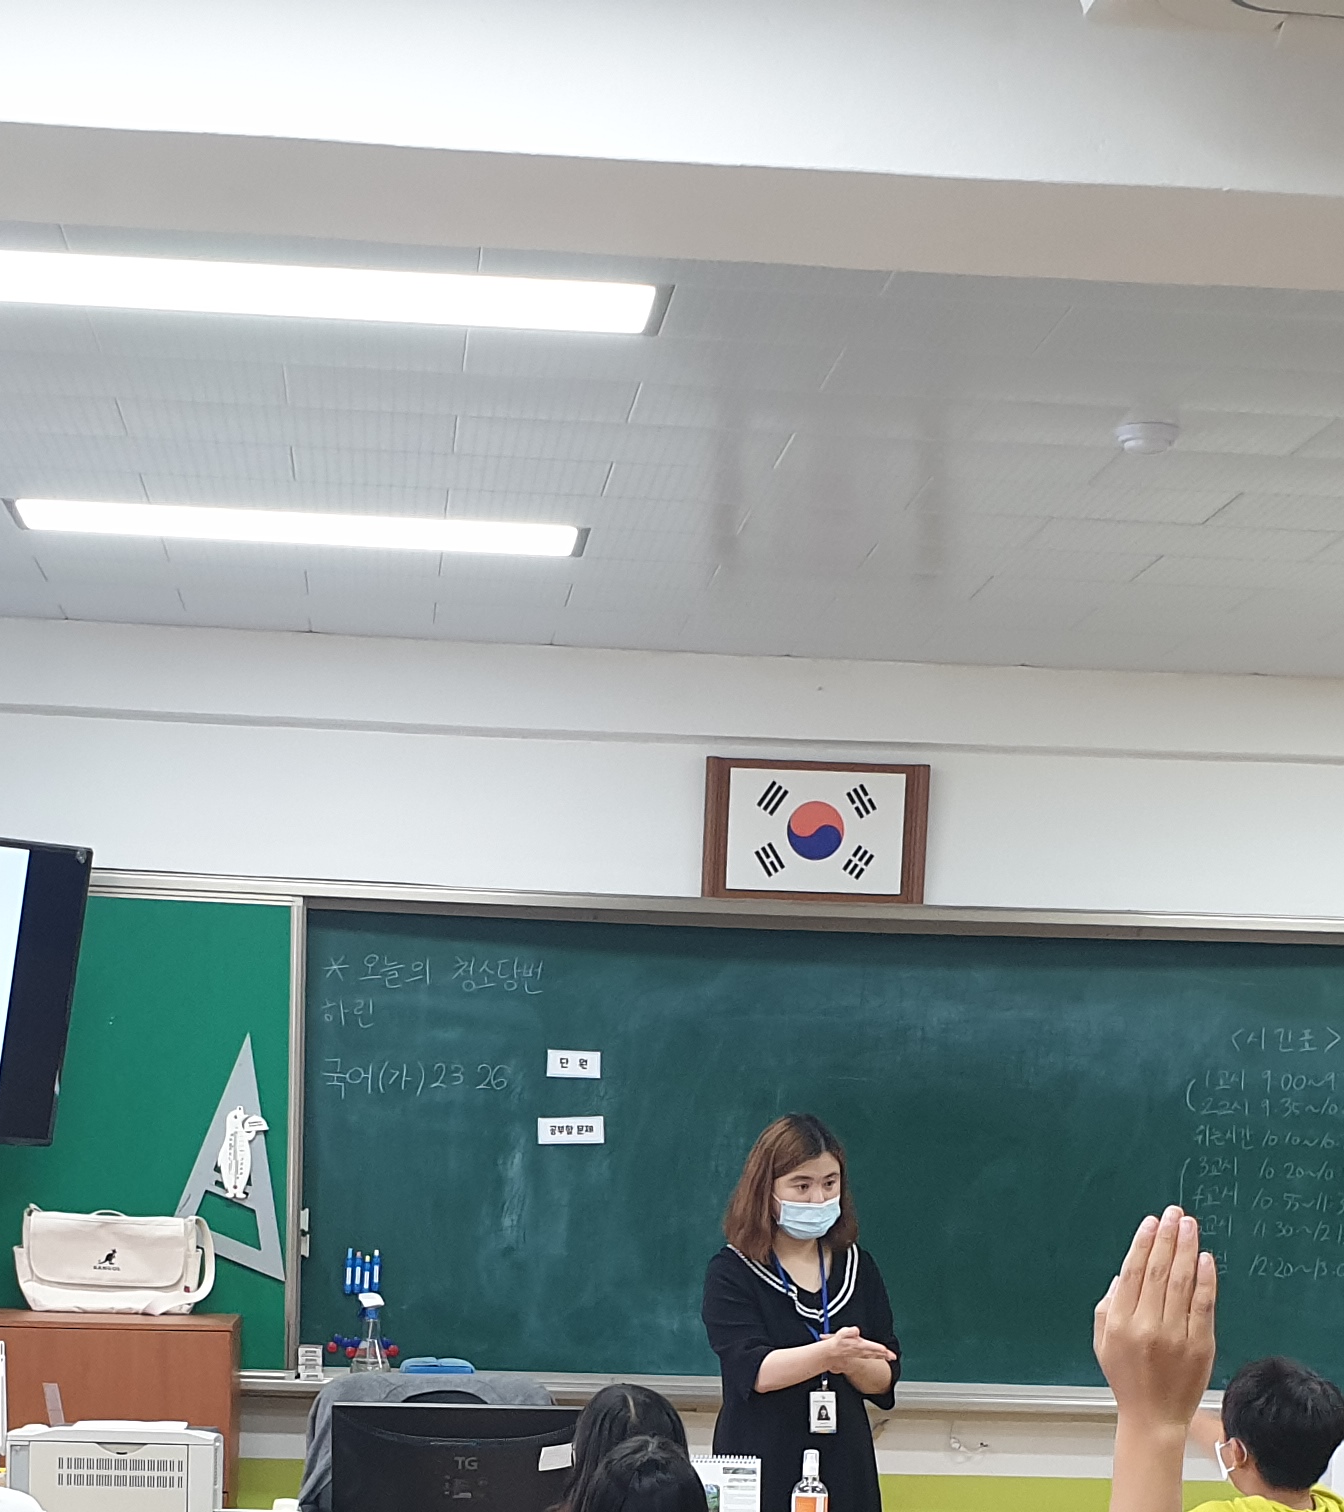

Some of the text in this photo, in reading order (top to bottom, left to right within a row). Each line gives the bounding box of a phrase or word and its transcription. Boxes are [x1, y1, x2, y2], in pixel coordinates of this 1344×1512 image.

[358, 953, 544, 995] 오늘의 청소당번
[321, 998, 375, 1029] 하린
[453, 1456, 478, 1470] TG
